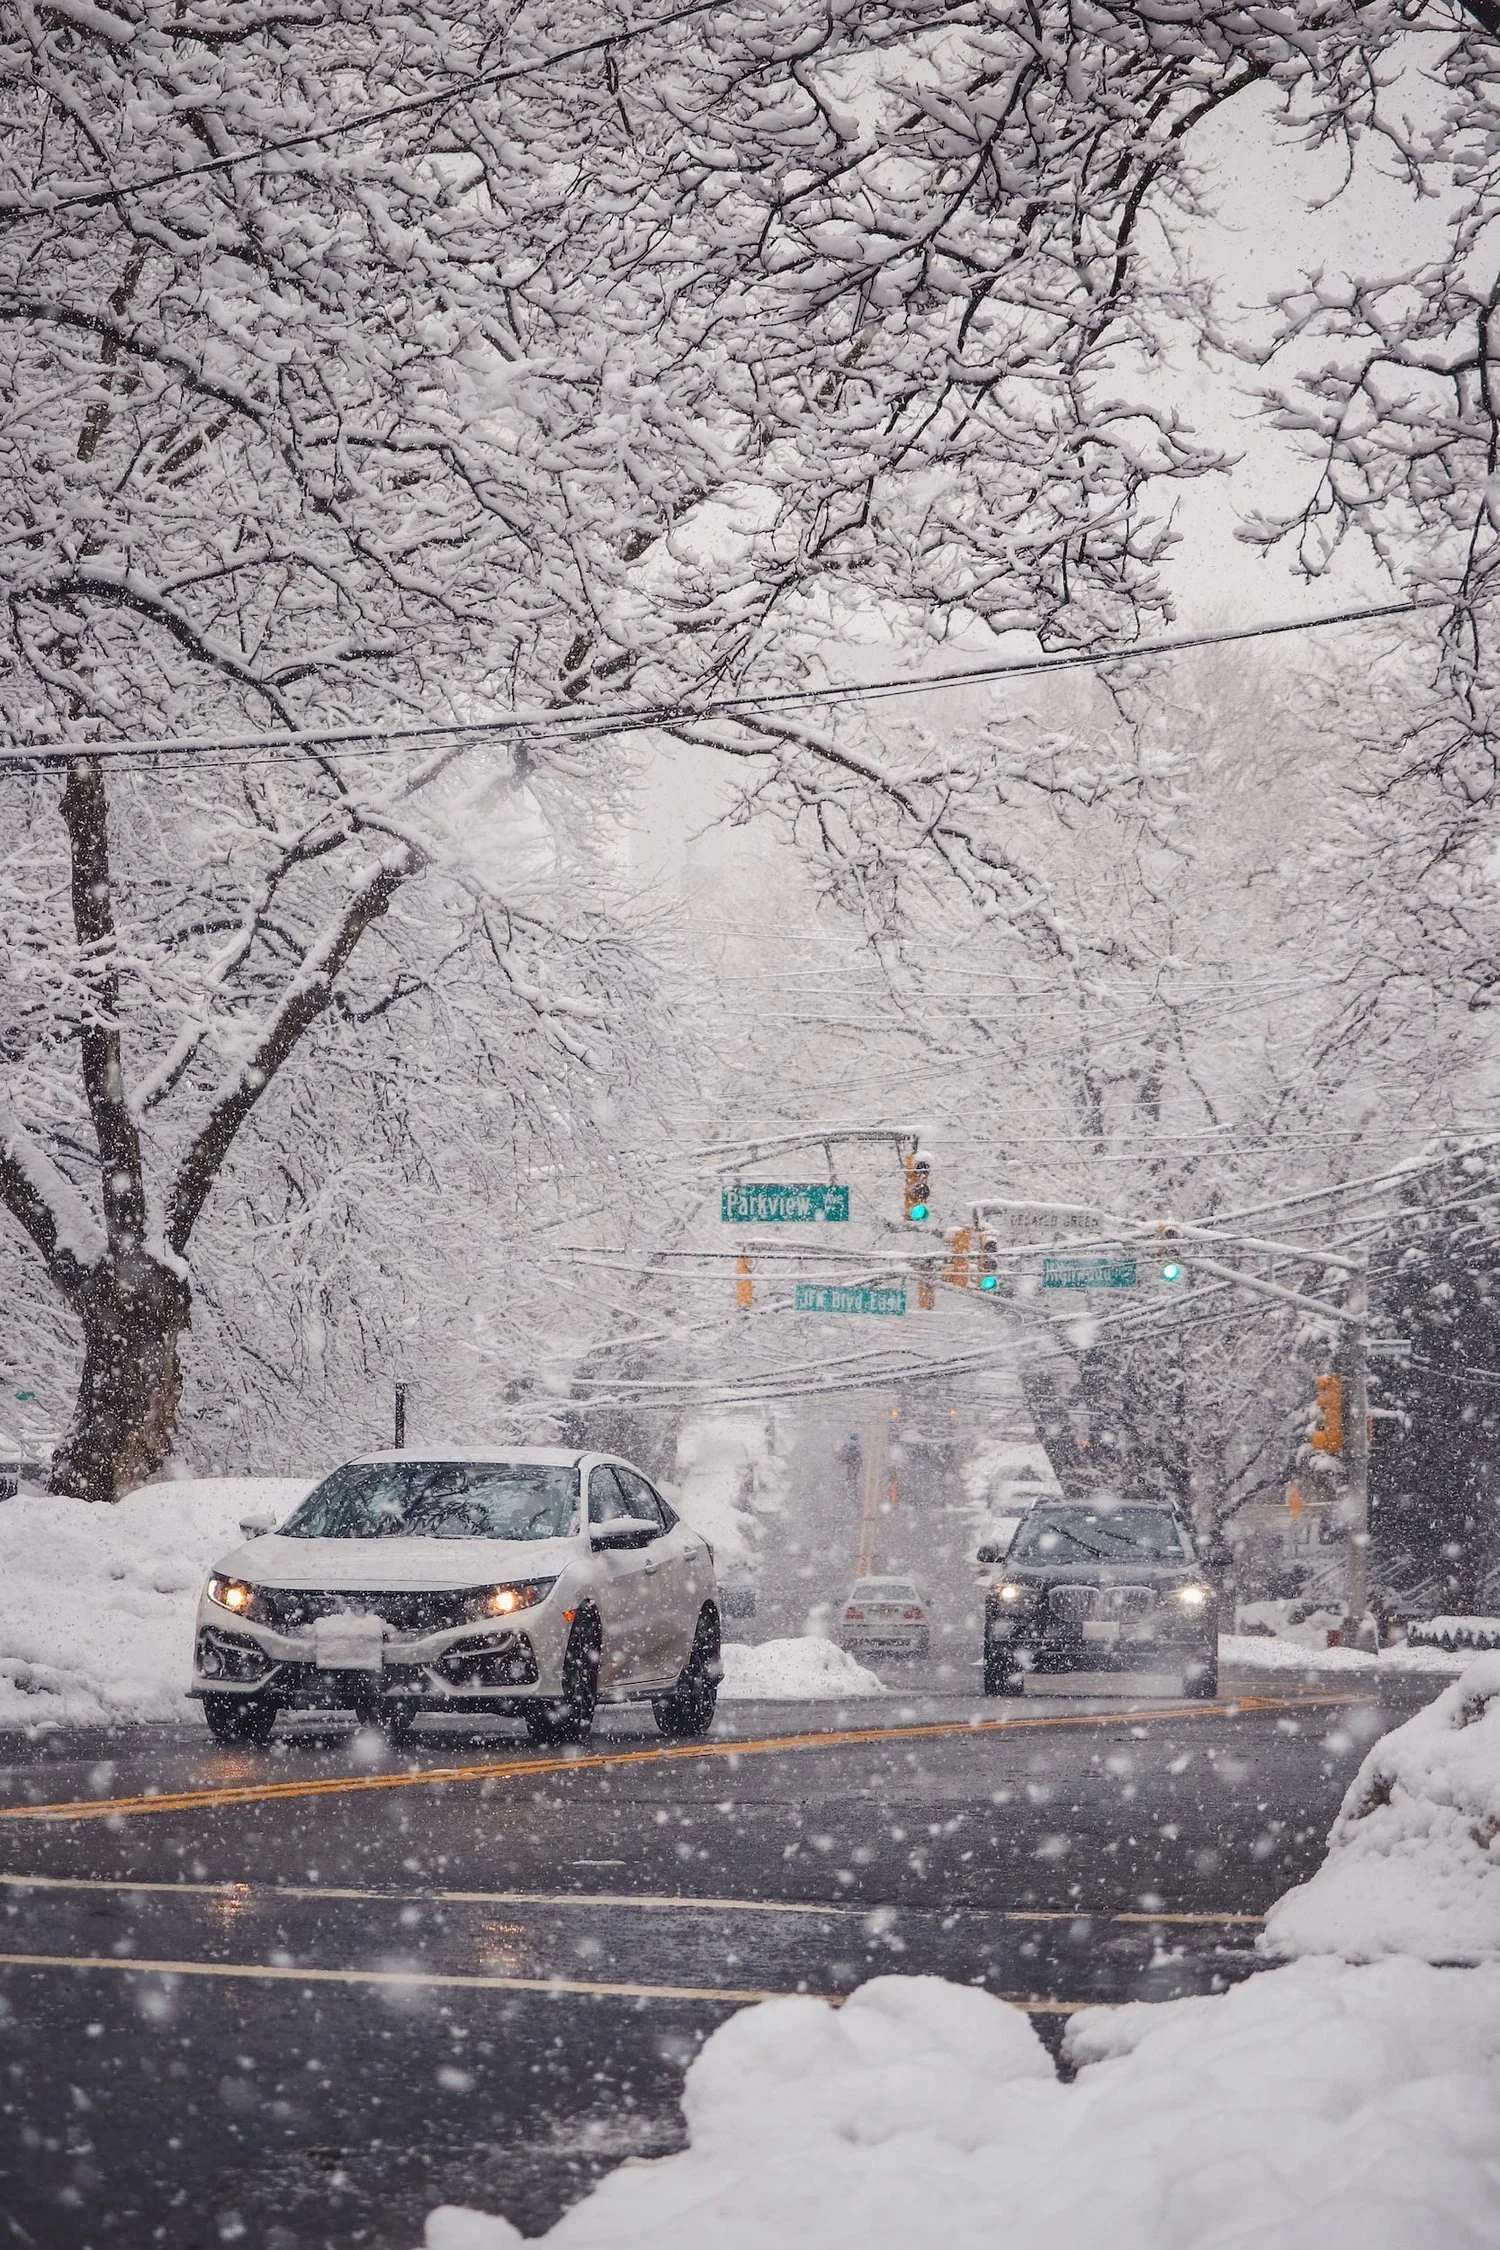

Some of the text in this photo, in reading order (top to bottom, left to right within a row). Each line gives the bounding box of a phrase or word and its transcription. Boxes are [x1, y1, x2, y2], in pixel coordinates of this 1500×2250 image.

[726, 1190, 810, 1218] Parkview
[832, 1291, 864, 1310] Blvd
[870, 1291, 902, 1312] East
